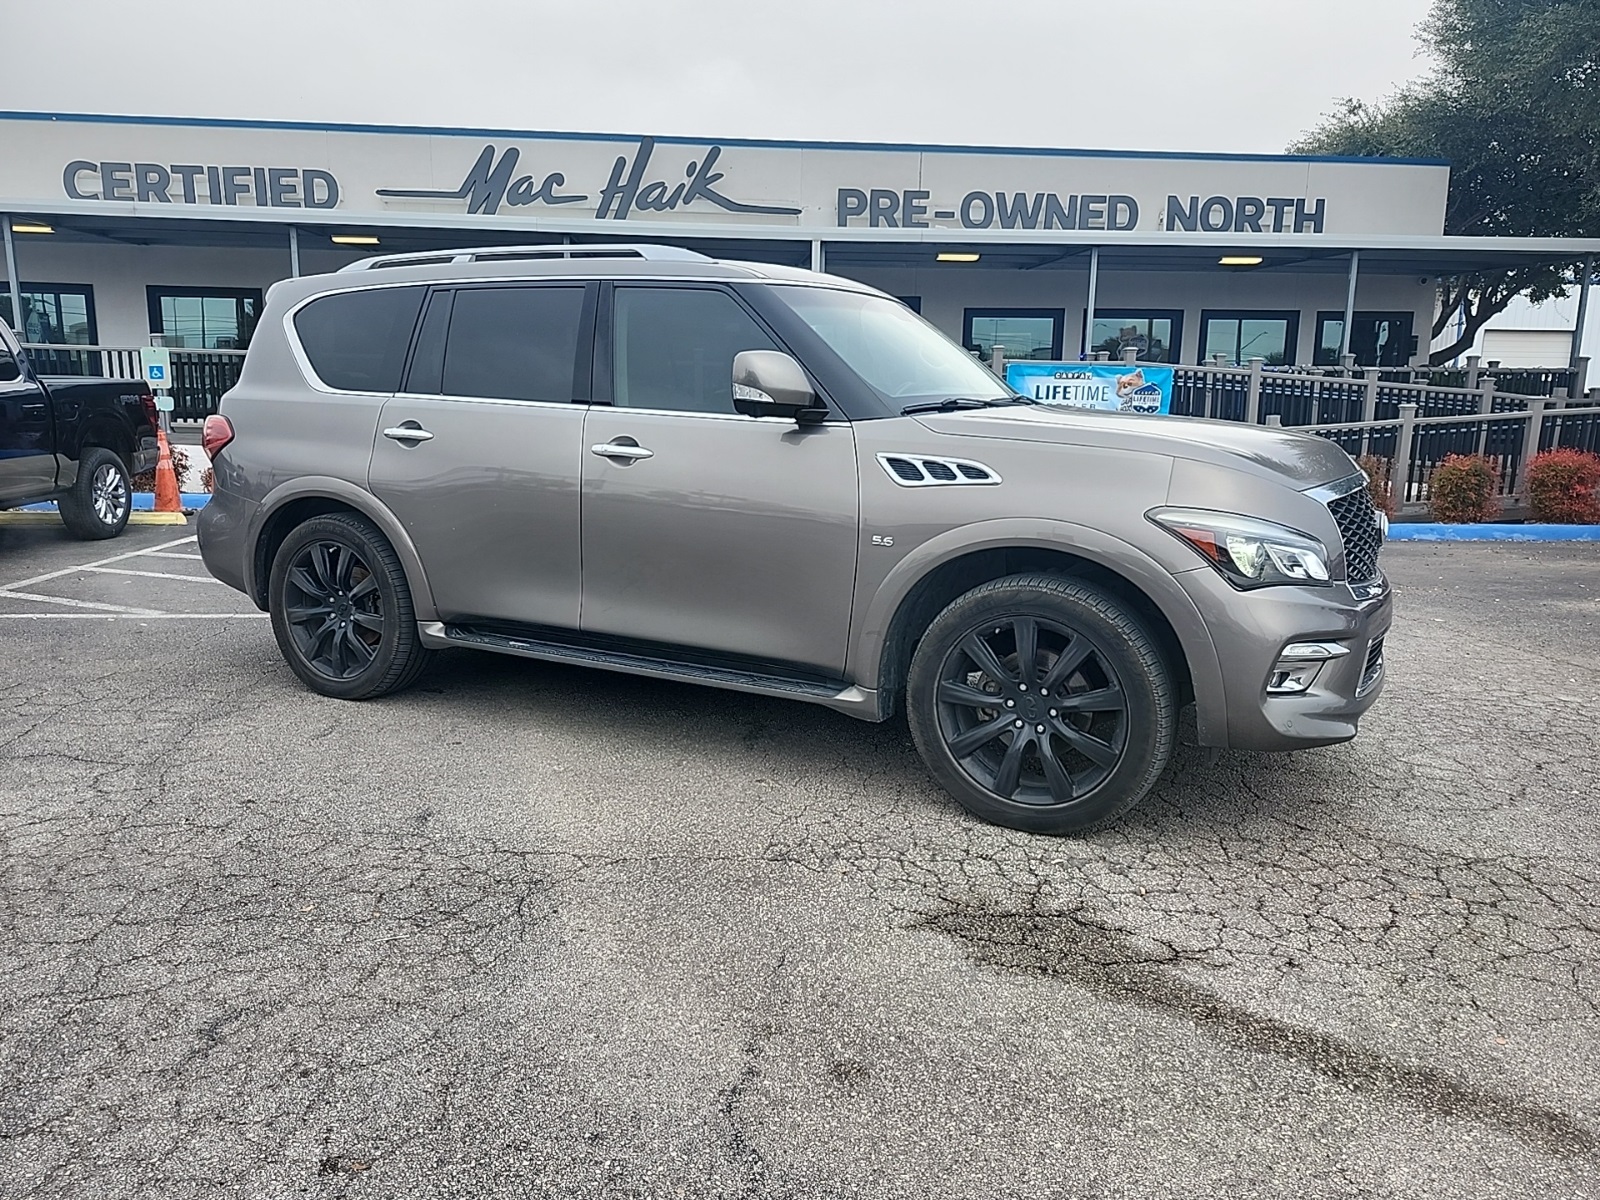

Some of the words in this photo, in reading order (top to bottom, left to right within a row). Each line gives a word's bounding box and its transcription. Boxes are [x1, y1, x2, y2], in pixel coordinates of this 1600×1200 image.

[63, 159, 339, 209] CERTIFIED
[376, 145, 588, 215] Mac
[594, 136, 802, 220] Haik
[837, 187, 1139, 232] PRE-OWNED
[1165, 194, 1326, 234] NORTH
[1054, 371, 1093, 380] CARFAX
[1035, 384, 1110, 402] LIFETIME
[871, 535, 894, 547] 5.6
